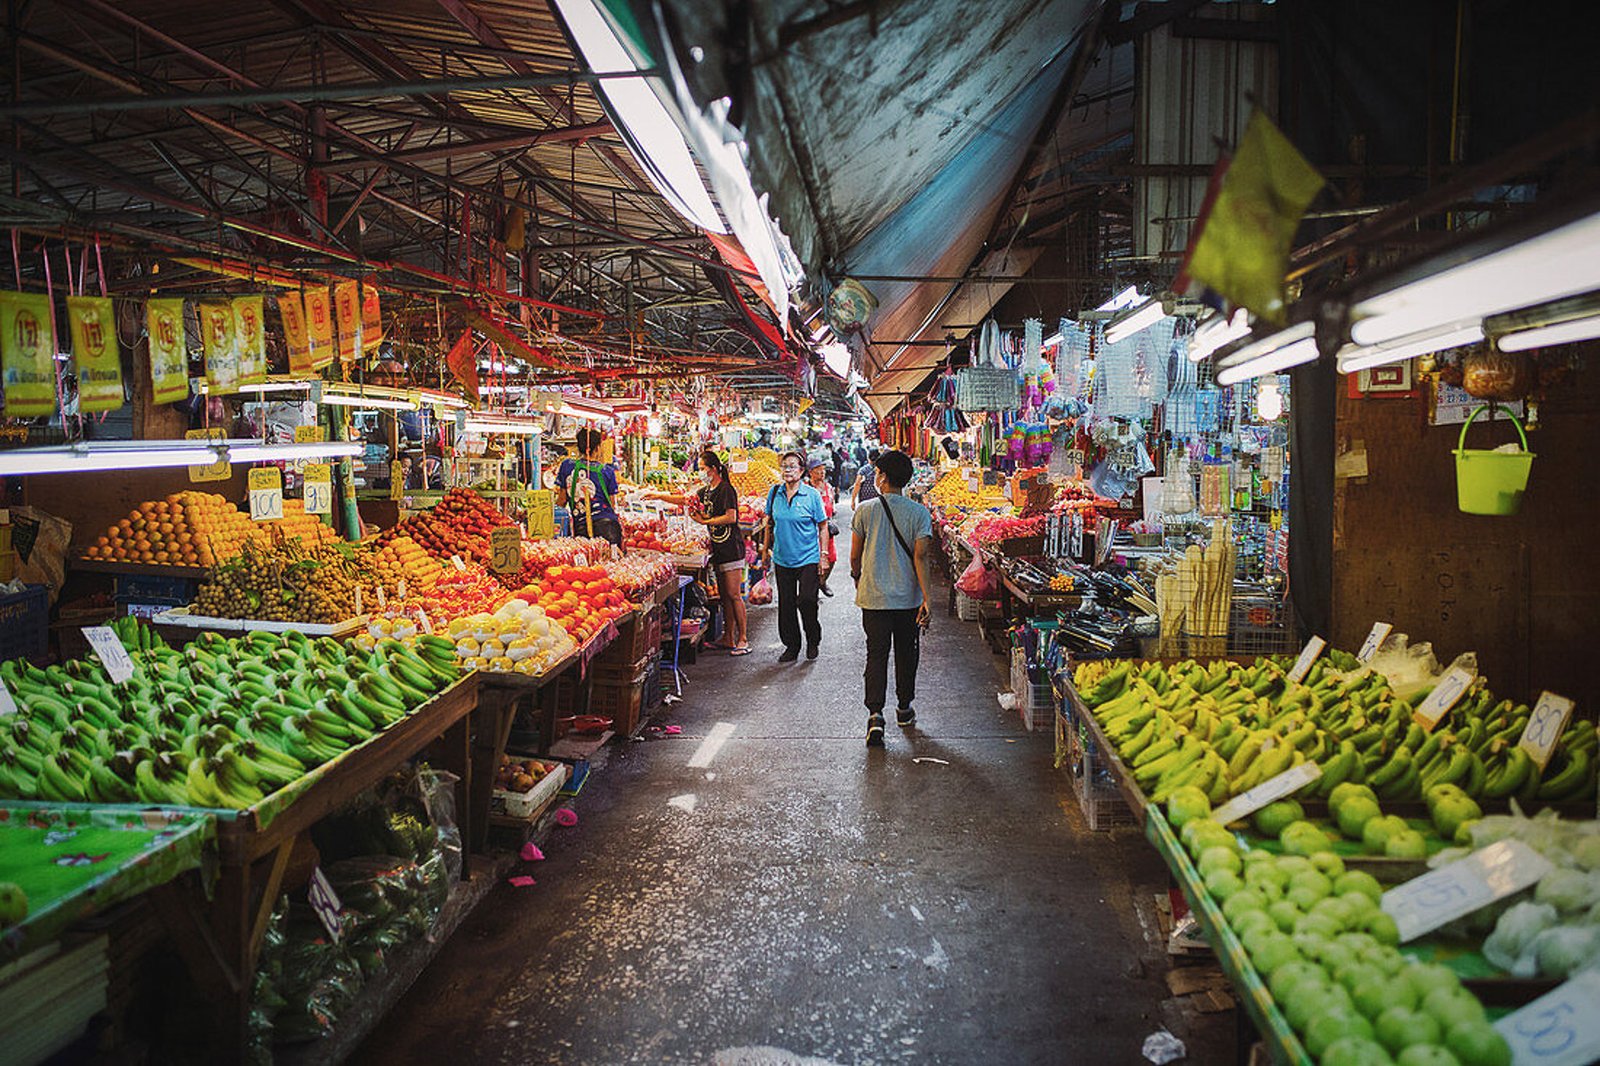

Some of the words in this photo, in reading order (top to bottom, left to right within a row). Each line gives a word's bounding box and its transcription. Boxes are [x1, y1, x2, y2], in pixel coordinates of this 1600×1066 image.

[251, 492, 283, 518] 100
[305, 485, 330, 512] 90
[494, 545, 520, 569] 50
[1526, 703, 1562, 747] 80
[1515, 1002, 1576, 1057] 50
